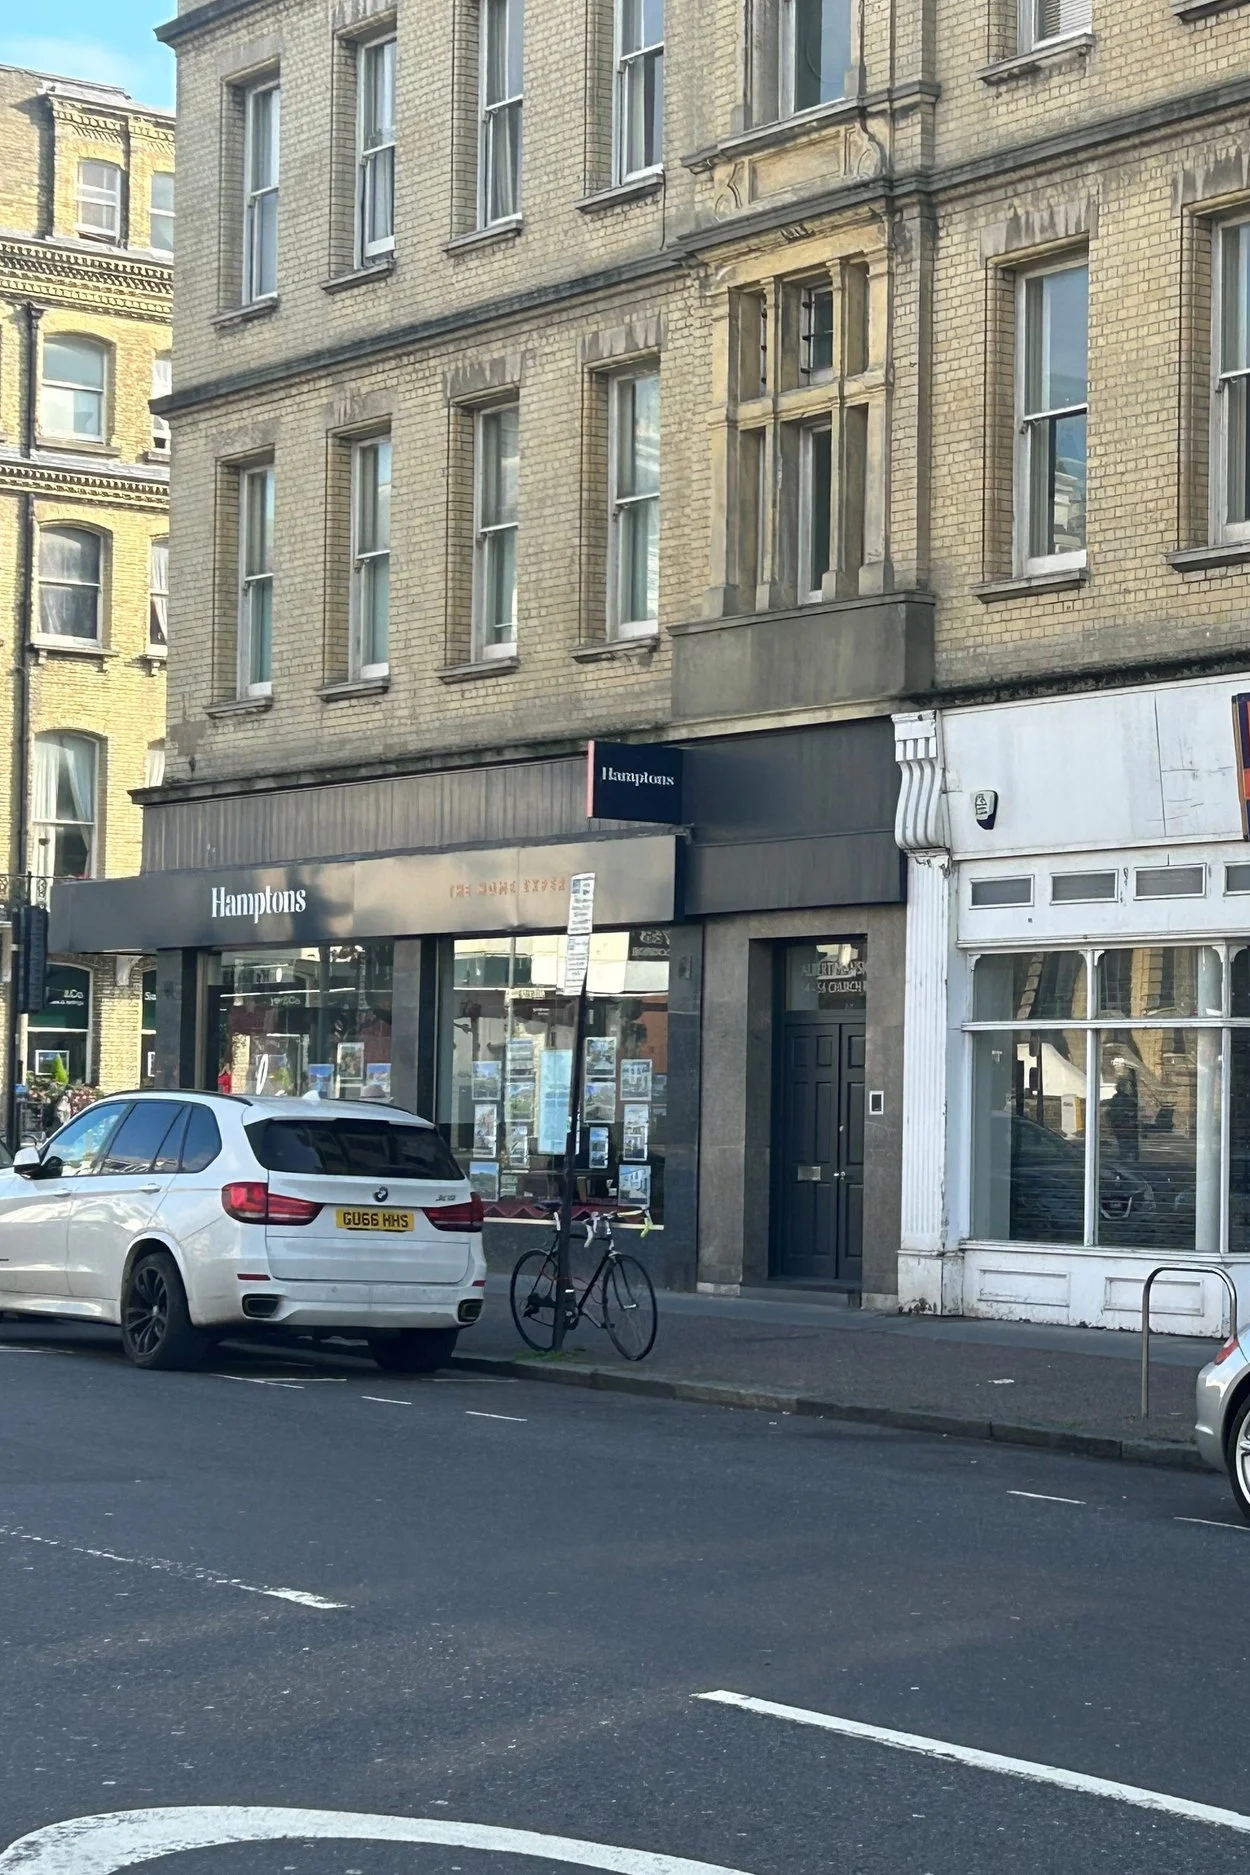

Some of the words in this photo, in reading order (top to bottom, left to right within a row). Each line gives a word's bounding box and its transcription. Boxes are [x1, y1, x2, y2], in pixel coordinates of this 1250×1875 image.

[602, 766, 675, 787] Hamptons
[211, 885, 306, 924] Hamptons
[343, 1212, 379, 1227] GU66
